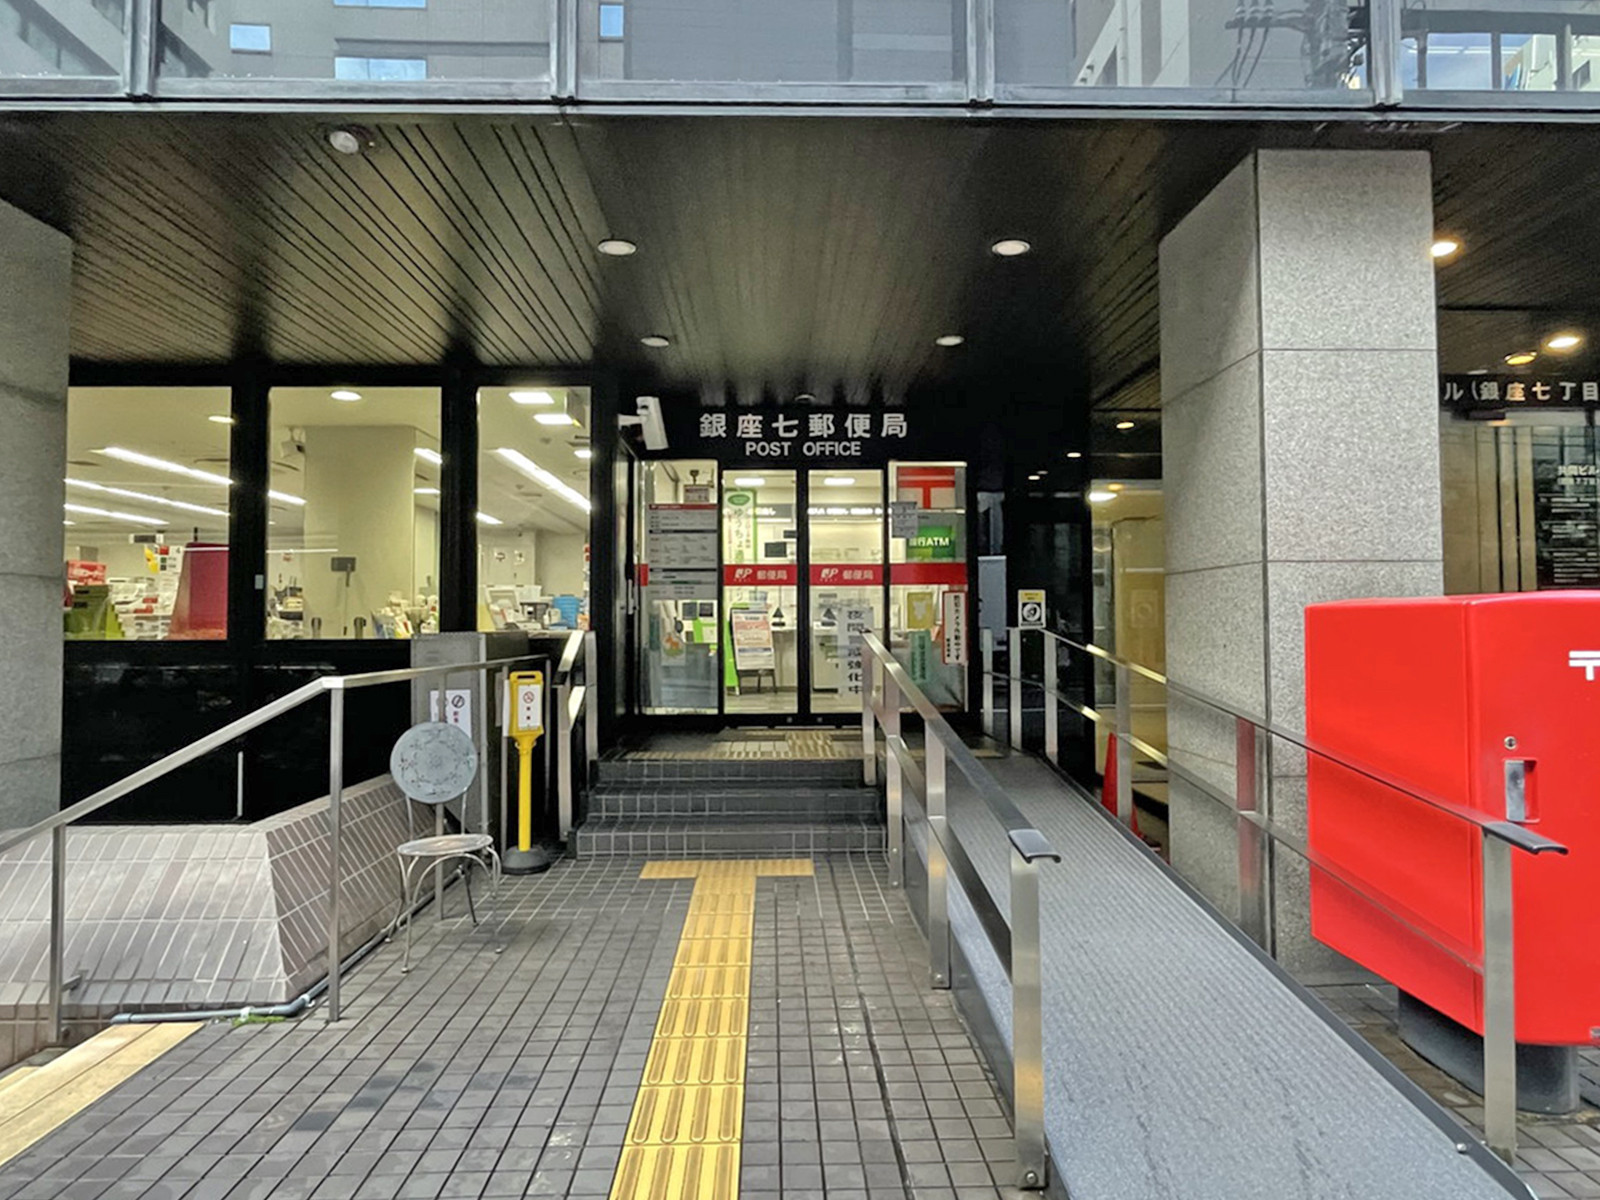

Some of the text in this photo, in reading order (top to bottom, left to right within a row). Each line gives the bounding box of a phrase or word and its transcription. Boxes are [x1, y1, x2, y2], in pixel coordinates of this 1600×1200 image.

[699, 413, 908, 438] 銀座七郵便局
[745, 441, 862, 456] POST OFFICE
